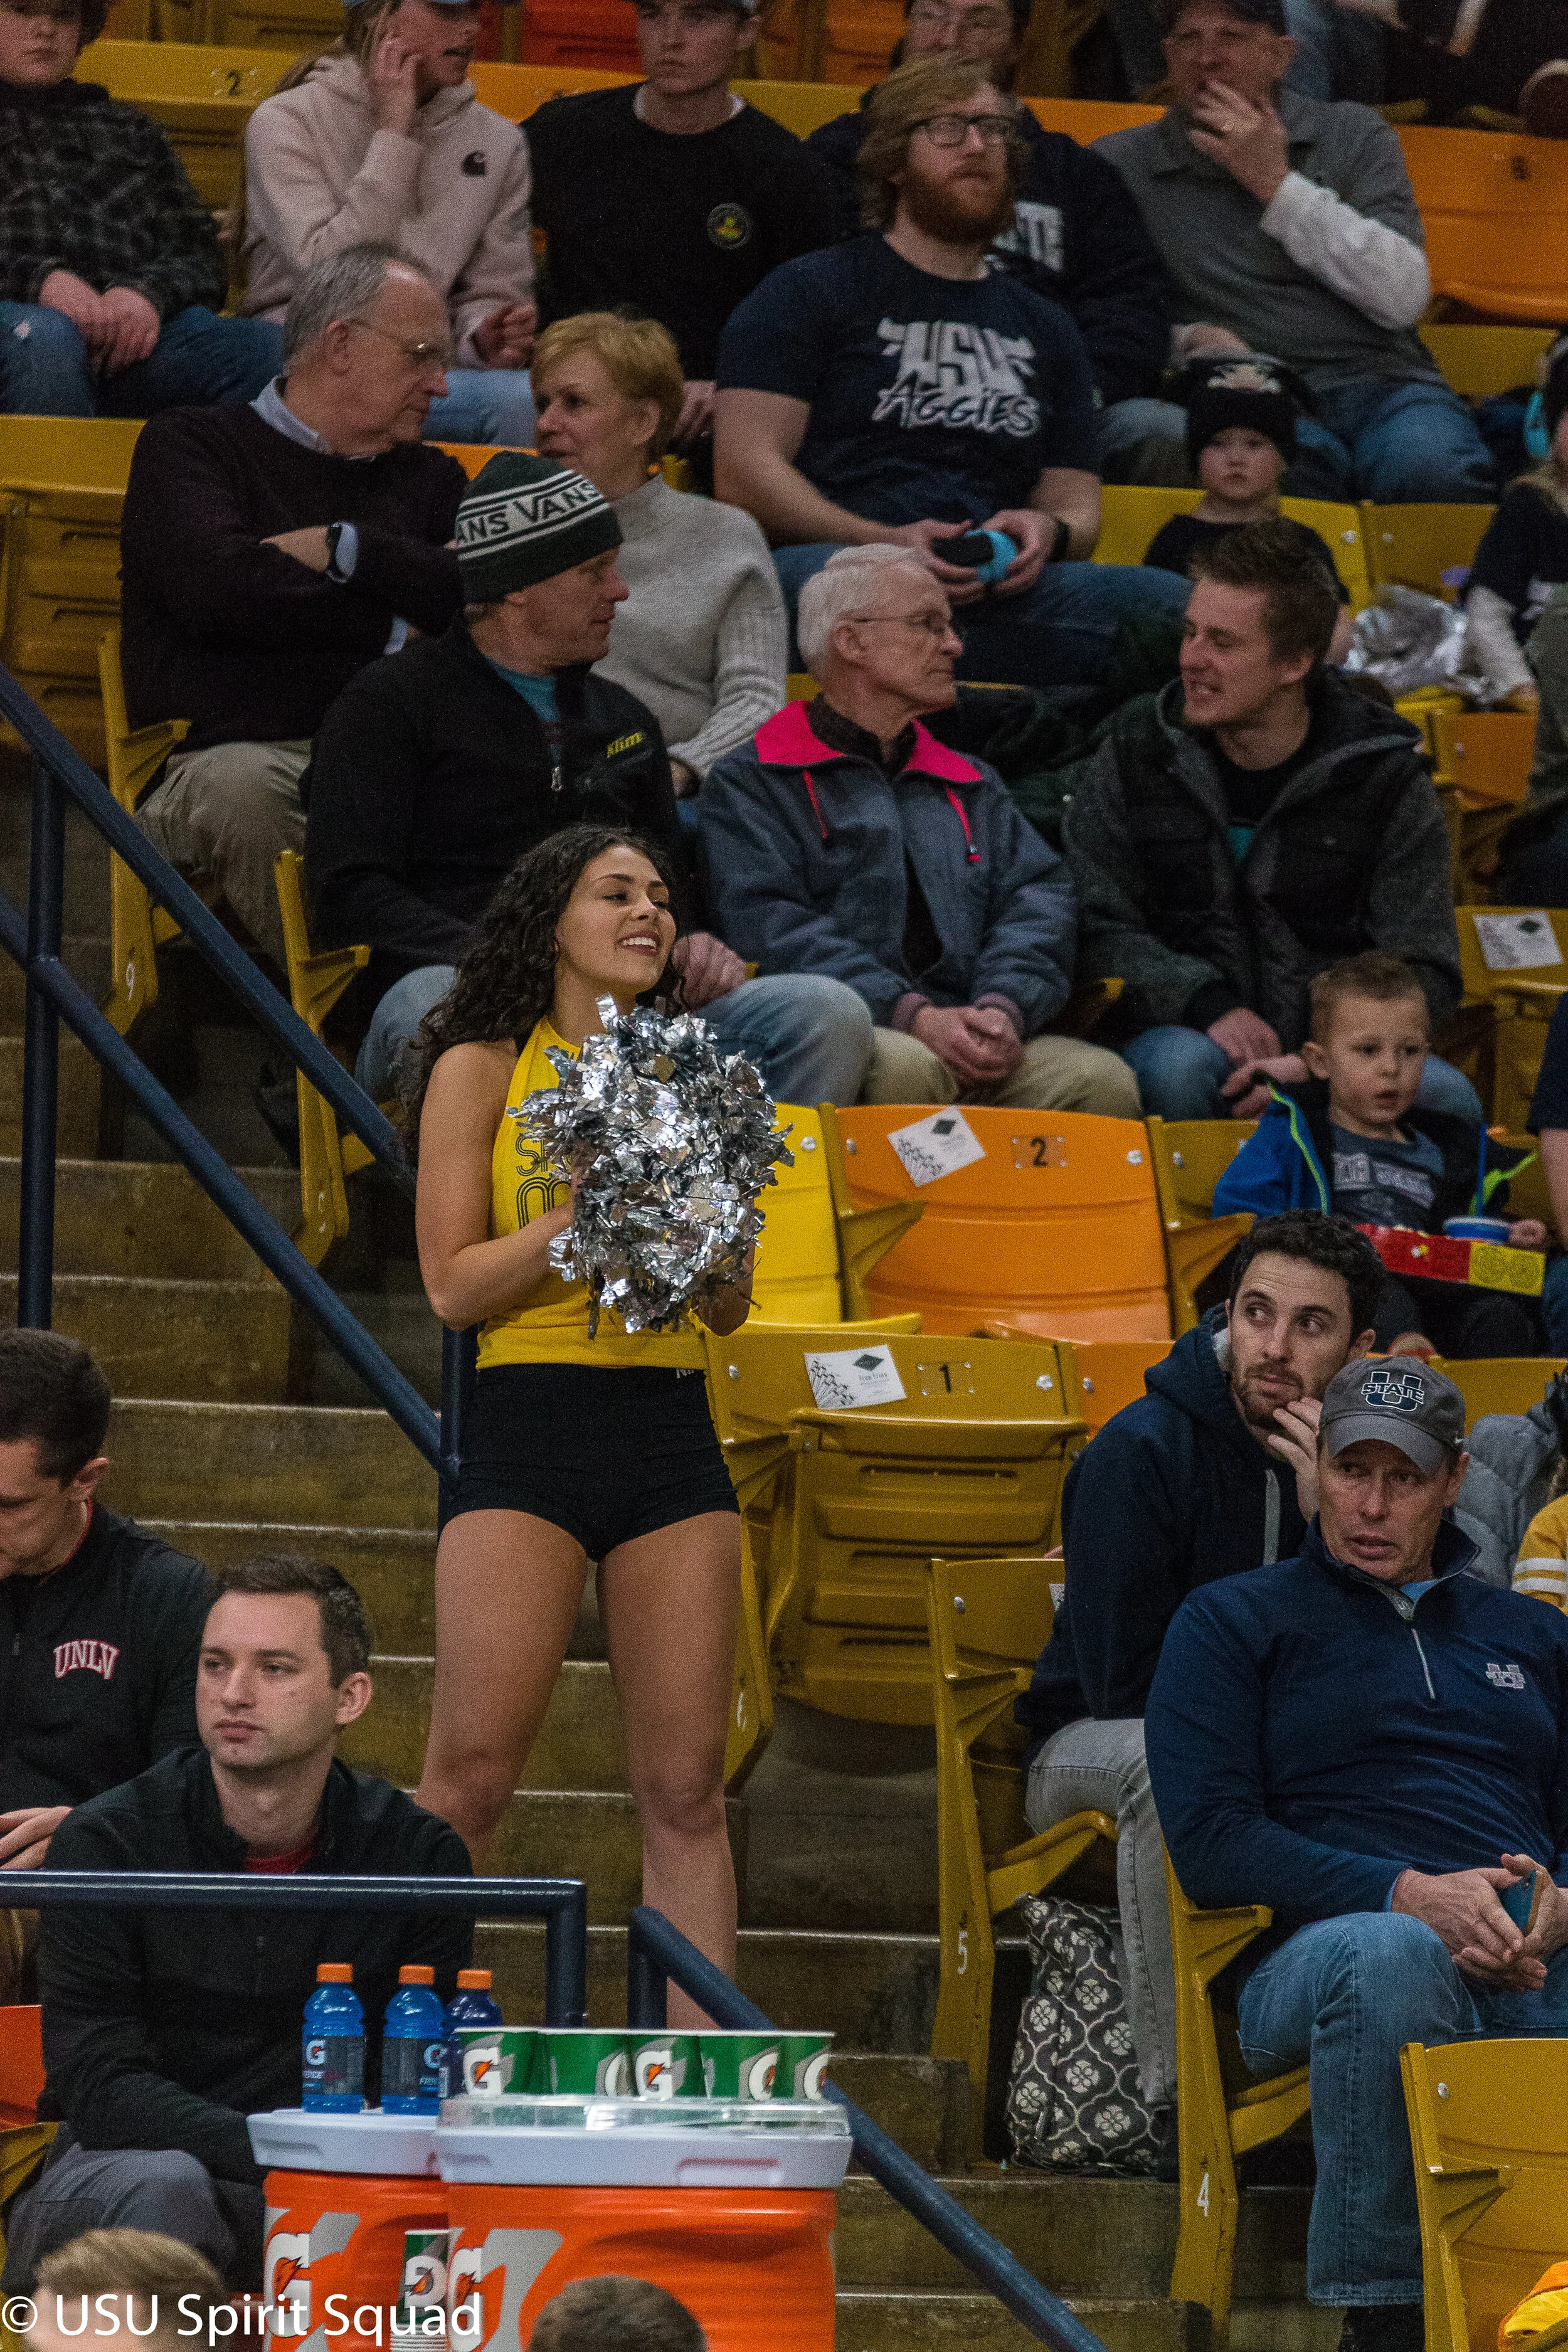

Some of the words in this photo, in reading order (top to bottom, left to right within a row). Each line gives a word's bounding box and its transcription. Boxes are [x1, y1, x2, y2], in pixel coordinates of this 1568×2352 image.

[226, 70, 241, 96] 2
[456, 511, 510, 543] ANS
[512, 479, 600, 522] VANS
[1030, 1136, 1047, 1167] 2
[939, 1364, 951, 1394] 1
[1361, 1382, 1424, 1404] STATE
[53, 1639, 120, 1680] UNLV
[957, 1931, 968, 1975] 5
[306, 2040, 326, 2065] G
[462, 2047, 502, 2097] G
[635, 2050, 673, 2100] G
[1197, 2173, 1209, 2218] 4
